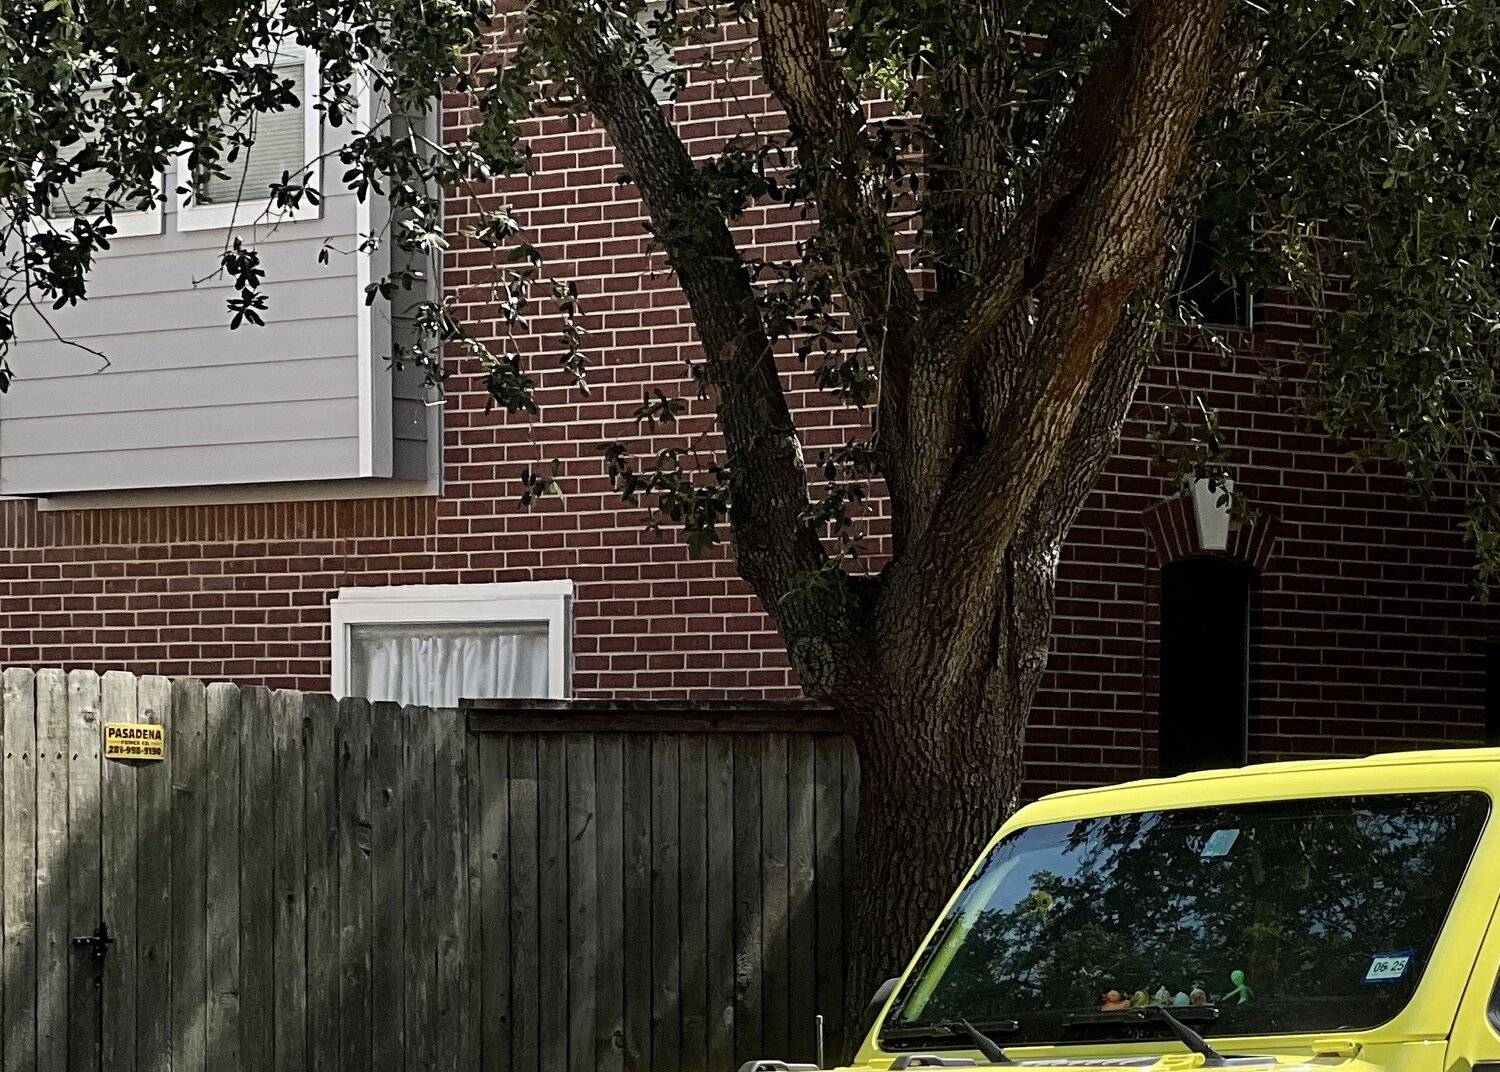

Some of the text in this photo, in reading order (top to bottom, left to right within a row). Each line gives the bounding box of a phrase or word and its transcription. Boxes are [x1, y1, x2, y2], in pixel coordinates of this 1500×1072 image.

[108, 728, 162, 741] PASADENA
[1373, 960, 1406, 973] 06 25
